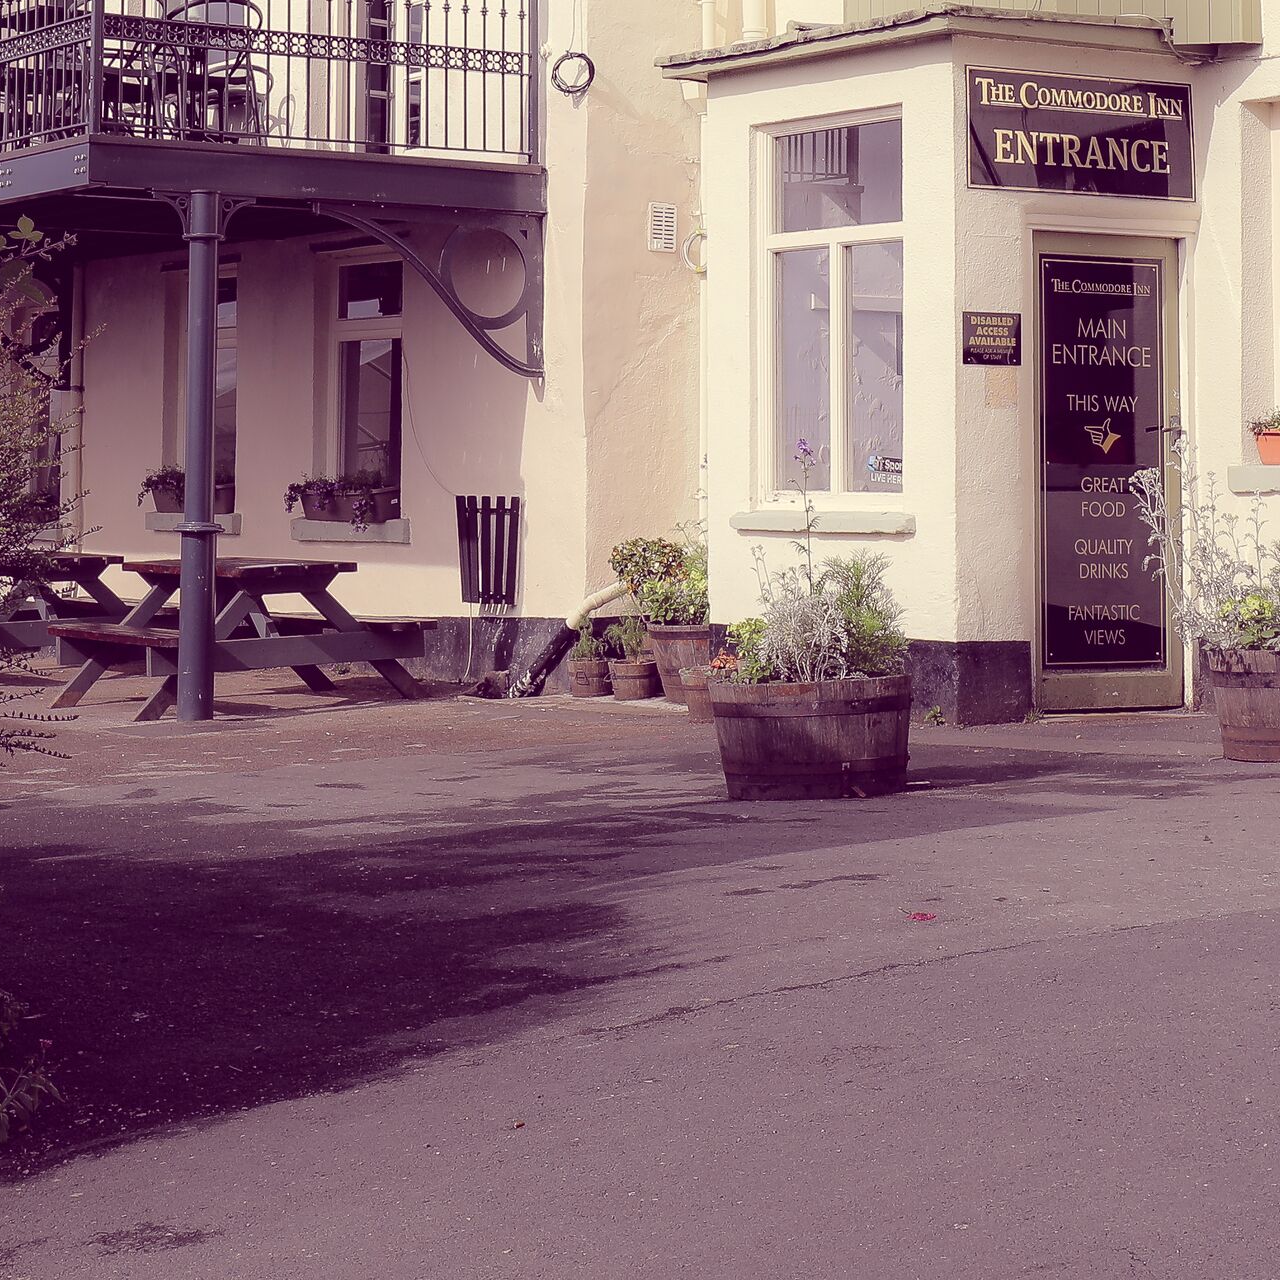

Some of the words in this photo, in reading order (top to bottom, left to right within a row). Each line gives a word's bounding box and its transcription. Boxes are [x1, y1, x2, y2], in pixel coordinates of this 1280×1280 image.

[975, 77, 1016, 106] THE
[1019, 81, 1144, 115] COMMODORE
[1147, 92, 1183, 119] INN
[993, 128, 1170, 174] ENTRANCE
[1051, 278, 1070, 292] THE
[1072, 279, 1132, 294] COMMODORE
[1133, 282, 1151, 296] INN
[970, 316, 1013, 326] DISABLED
[1077, 317, 1127, 339] MAIN
[976, 326, 1009, 336] ACCESS
[969, 336, 1016, 346] AVAILABLE
[1052, 343, 1151, 368] ENTRANCE
[1066, 394, 1100, 412] THIS
[1104, 395, 1139, 414] WAY
[870, 472, 886, 483] LIVE
[1080, 476, 1126, 494] GREAT
[1081, 501, 1126, 518] FOOD
[1074, 538, 1133, 557] QUALITY
[1079, 562, 1129, 580] DRINKS
[1068, 604, 1141, 621] FANTASTIC
[1084, 629, 1126, 646] VIEWS
